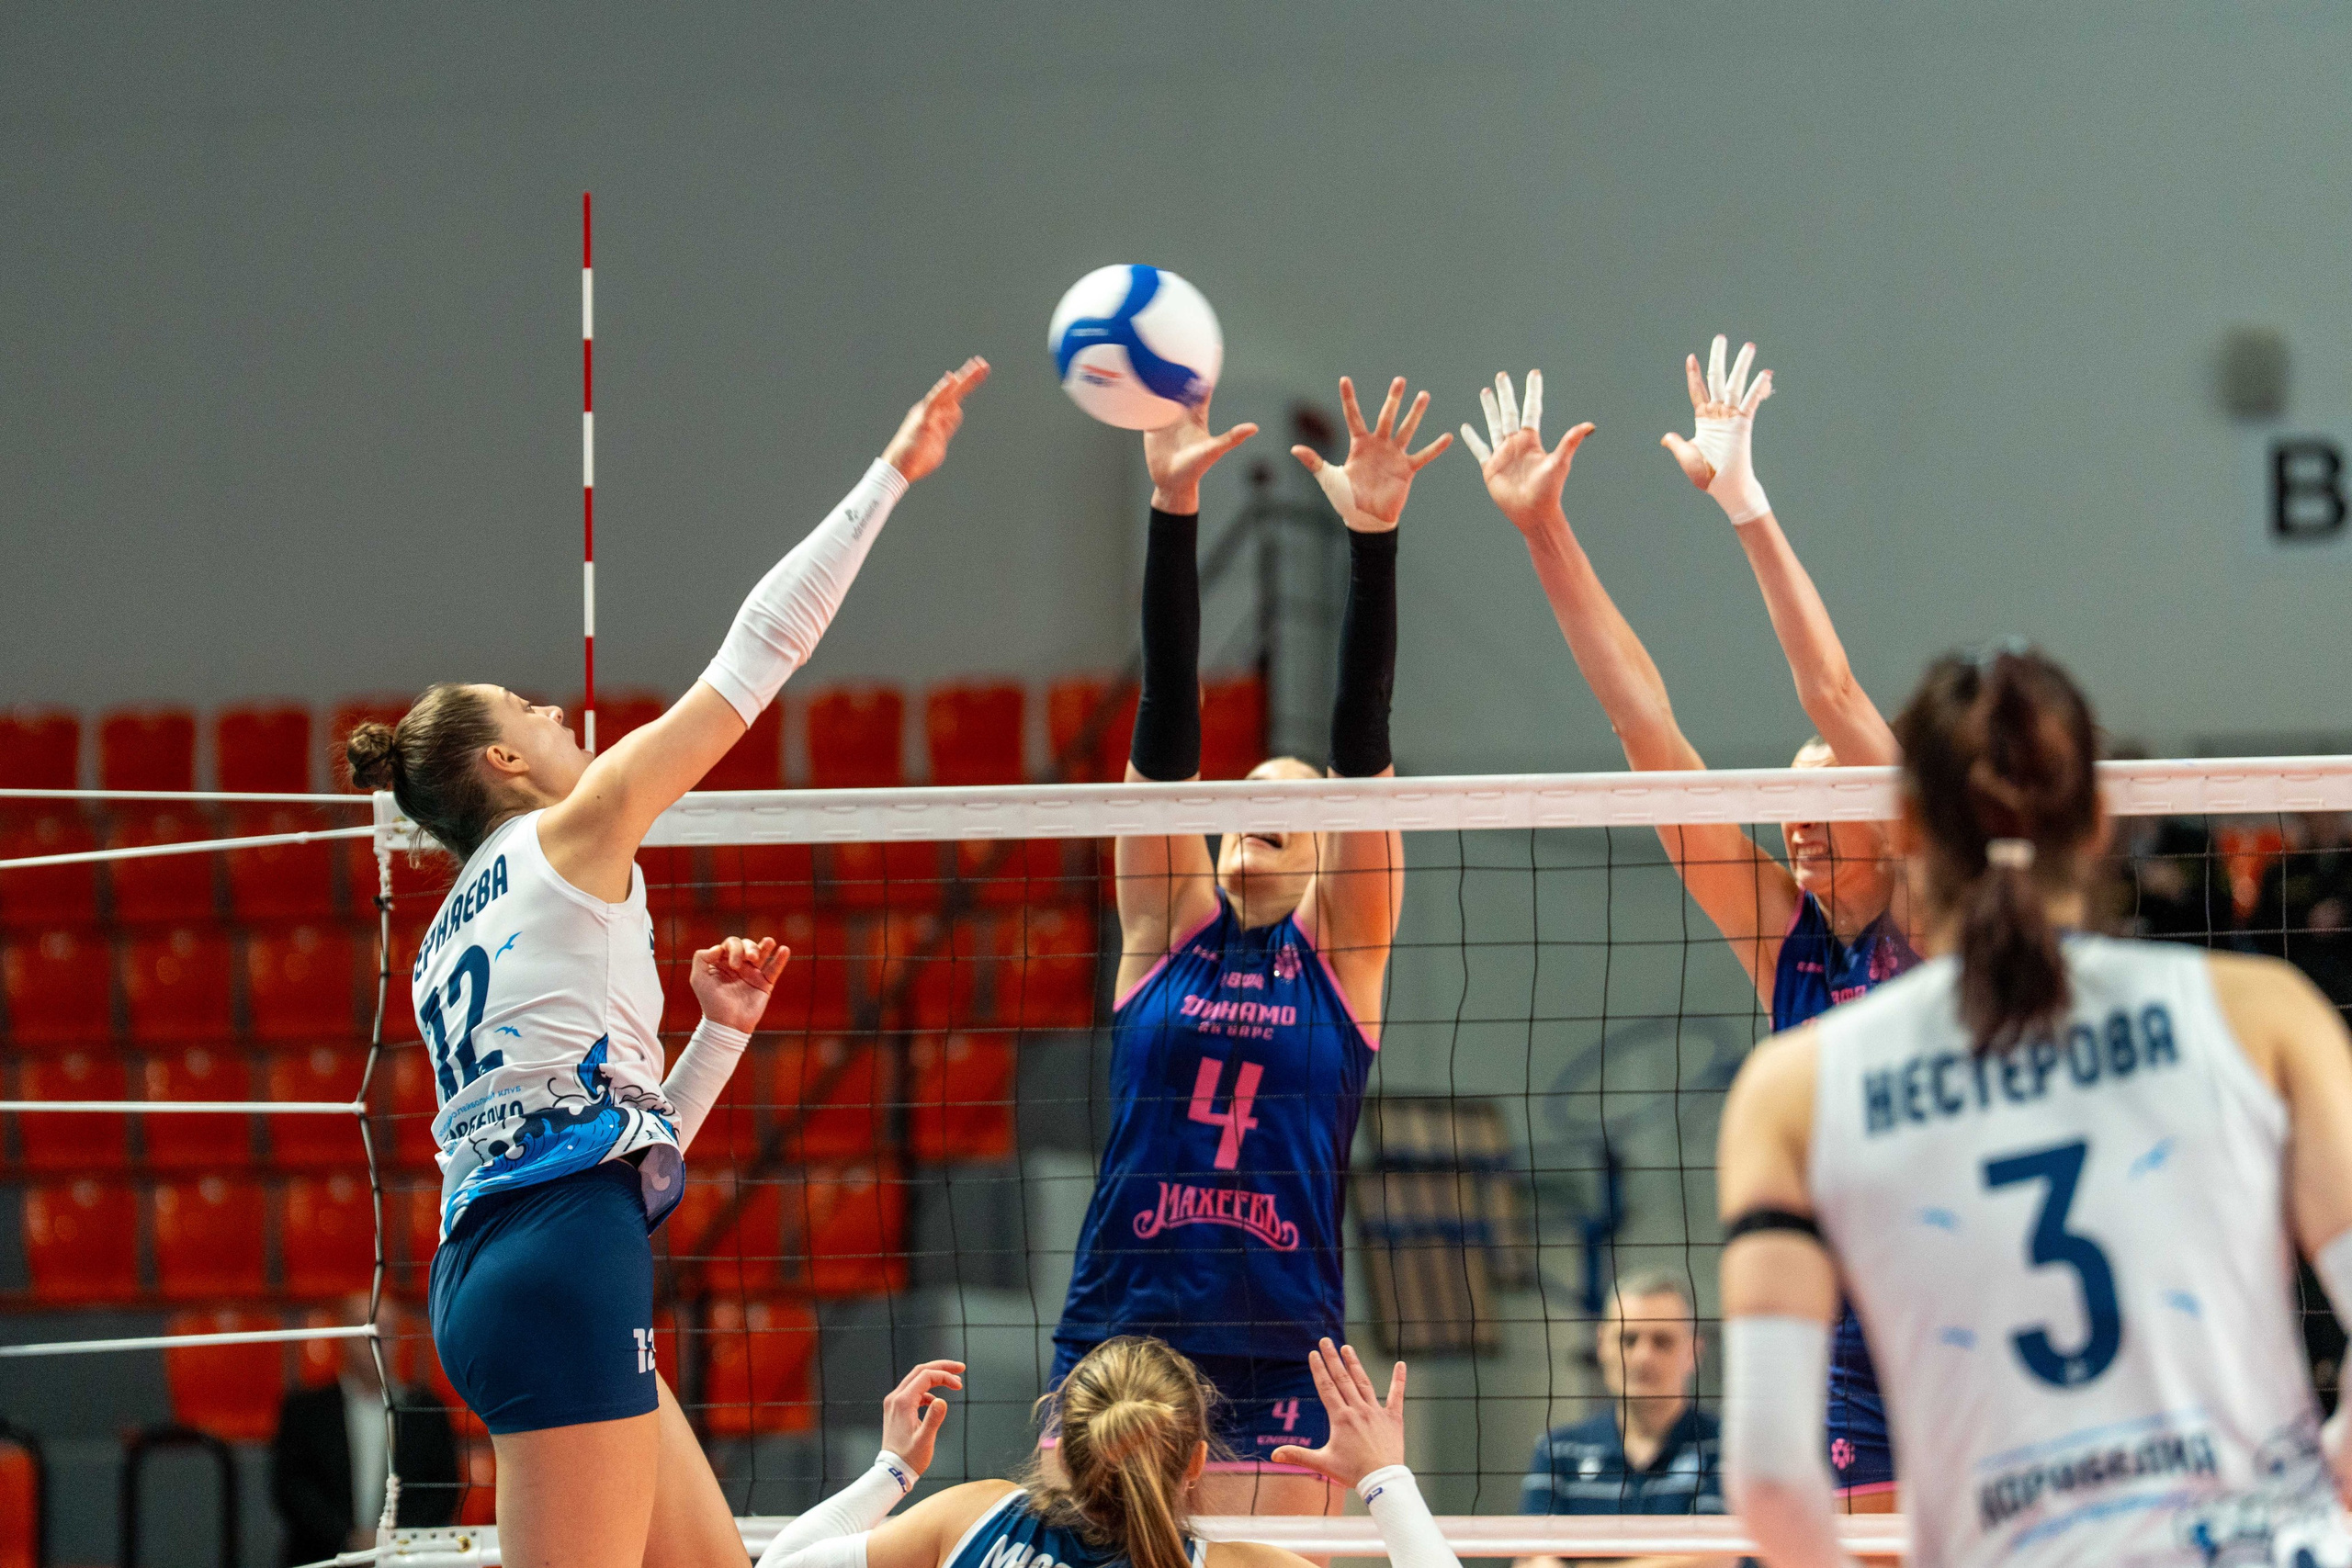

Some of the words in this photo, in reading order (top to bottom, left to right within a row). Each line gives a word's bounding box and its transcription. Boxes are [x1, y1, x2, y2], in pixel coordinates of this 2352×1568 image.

[413, 853, 508, 983] ЕРНЯЕВА
[419, 944, 504, 1104] 12
[1864, 1002, 2179, 1139] НЕСТЕРОВА
[1187, 1056, 1264, 1170] 4
[1982, 1137, 2121, 1390] 3
[1272, 1397, 1299, 1432] 4
